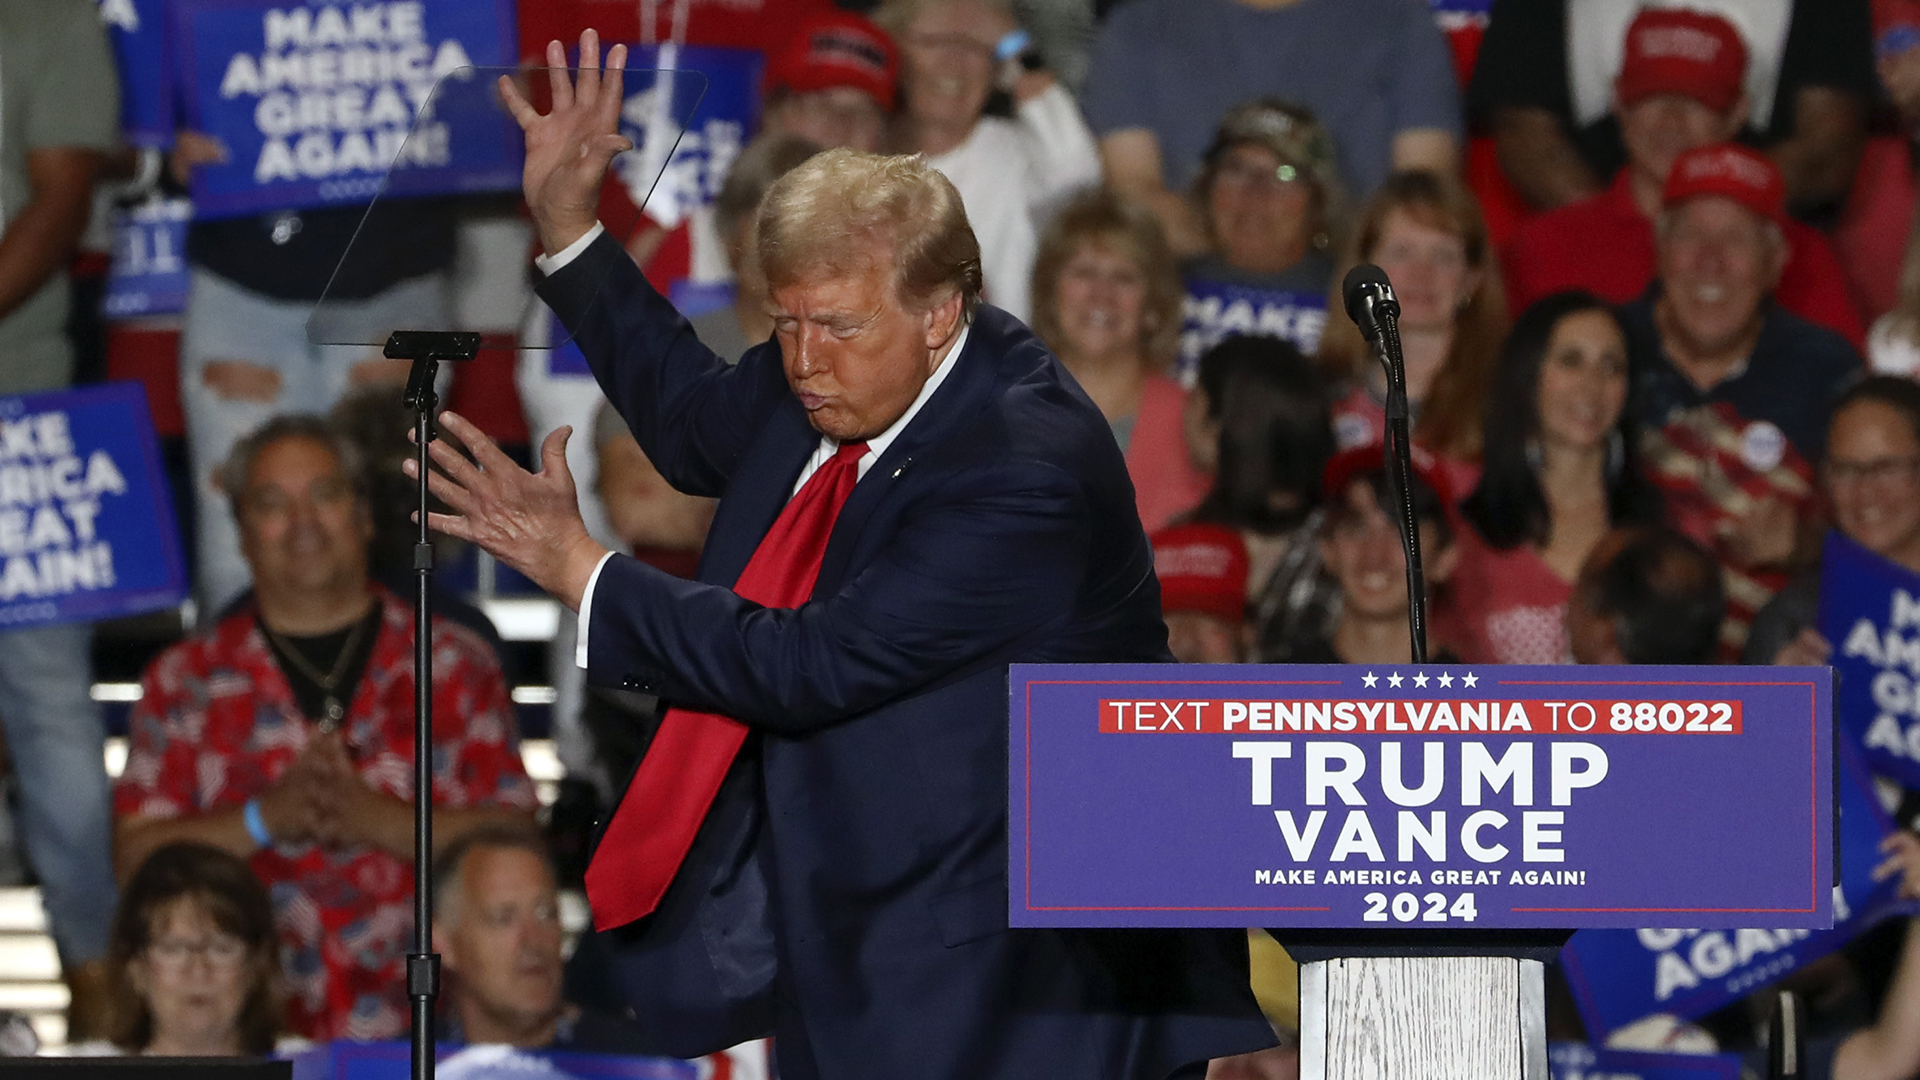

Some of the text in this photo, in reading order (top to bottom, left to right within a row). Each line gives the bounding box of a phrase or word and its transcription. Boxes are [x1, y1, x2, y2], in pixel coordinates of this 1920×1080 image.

[263, 2, 425, 50] MAKE
[219, 38, 475, 99] AMERICA
[254, 82, 437, 138] GREAT
[254, 120, 451, 184] AGAIN!
[0, 411, 75, 455] KE
[0, 450, 128, 503] RICA
[0, 498, 101, 551] EAT
[0, 540, 118, 600] AIN!
[1108, 701, 1733, 733] TEXT PENNSYLVANIA TO 88022
[1232, 741, 1609, 807] TRUMP
[1273, 809, 1566, 863] VANCE
[1255, 870, 1586, 886] MAKE AMERICA GREAT AGAIN!
[1363, 892, 1478, 922] 2024
